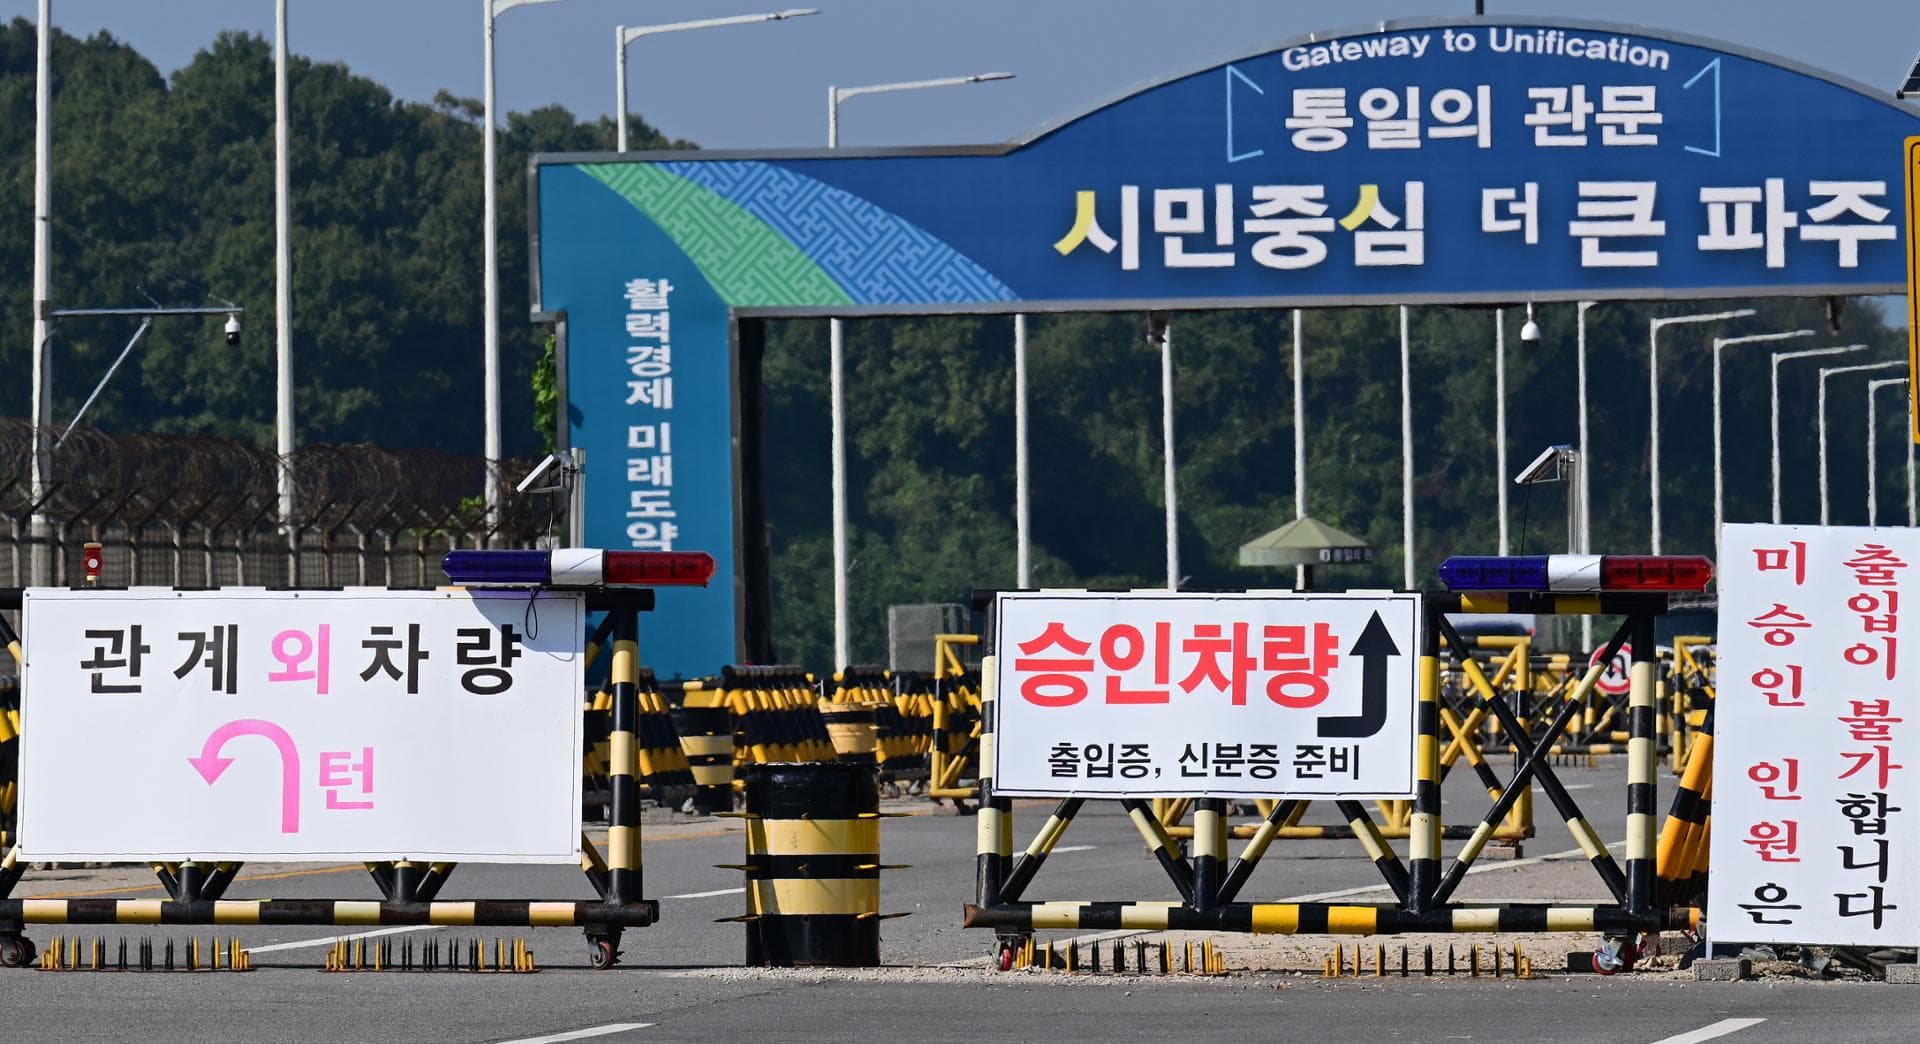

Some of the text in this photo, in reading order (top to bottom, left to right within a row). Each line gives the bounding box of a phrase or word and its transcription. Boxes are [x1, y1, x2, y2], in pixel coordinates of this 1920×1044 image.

[1282, 28, 1669, 71] Gateway to Unification
[1286, 85, 1662, 151] 통일의 관문
[1055, 179, 1896, 269] 시민중심 더 큰 파주
[625, 280, 677, 551] 활력경제 미래도약
[1015, 622, 1339, 708] 승인차량
[1048, 743, 1359, 780] 출입증, 신분증 준비
[1834, 544, 1907, 930] 출입이 불가합니다
[320, 748, 373, 809] 턴
